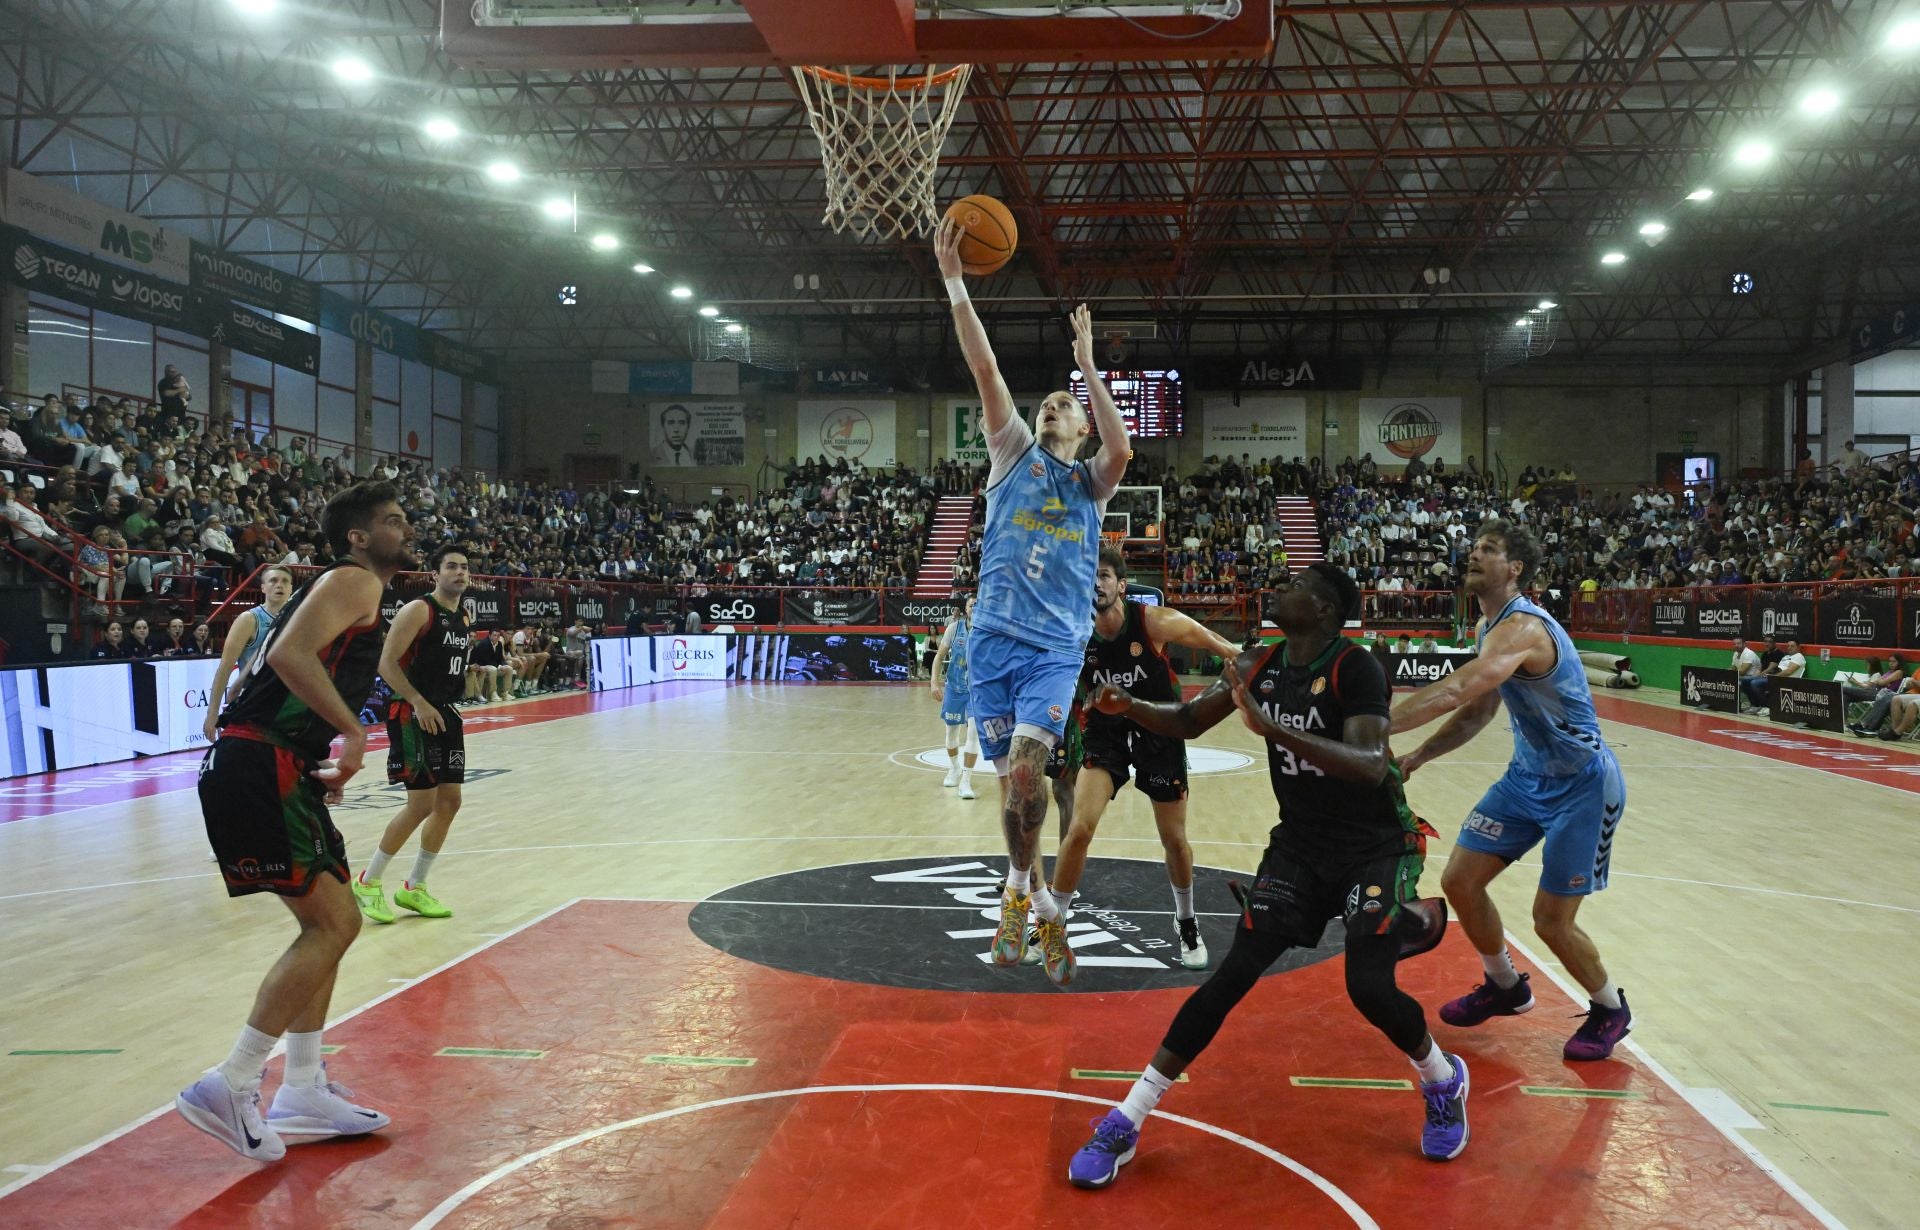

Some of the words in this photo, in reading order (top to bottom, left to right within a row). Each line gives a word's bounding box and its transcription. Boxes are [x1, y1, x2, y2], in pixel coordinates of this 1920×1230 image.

[42, 255, 101, 289] TECAN
[350, 309, 394, 350] alsa
[817, 370, 869, 383] LAVIN
[1240, 361, 1316, 386] AlegA
[1379, 421, 1443, 444] CANTABRIA
[1011, 513, 1084, 546] agropal
[1026, 543, 1049, 579] 5
[576, 597, 604, 620] úniko
[1838, 625, 1872, 636] CANALLA
[448, 656, 463, 675] 10
[1092, 664, 1149, 688] AlegA
[1396, 658, 1455, 681] AlegA
[1260, 701, 1326, 732] AlegA
